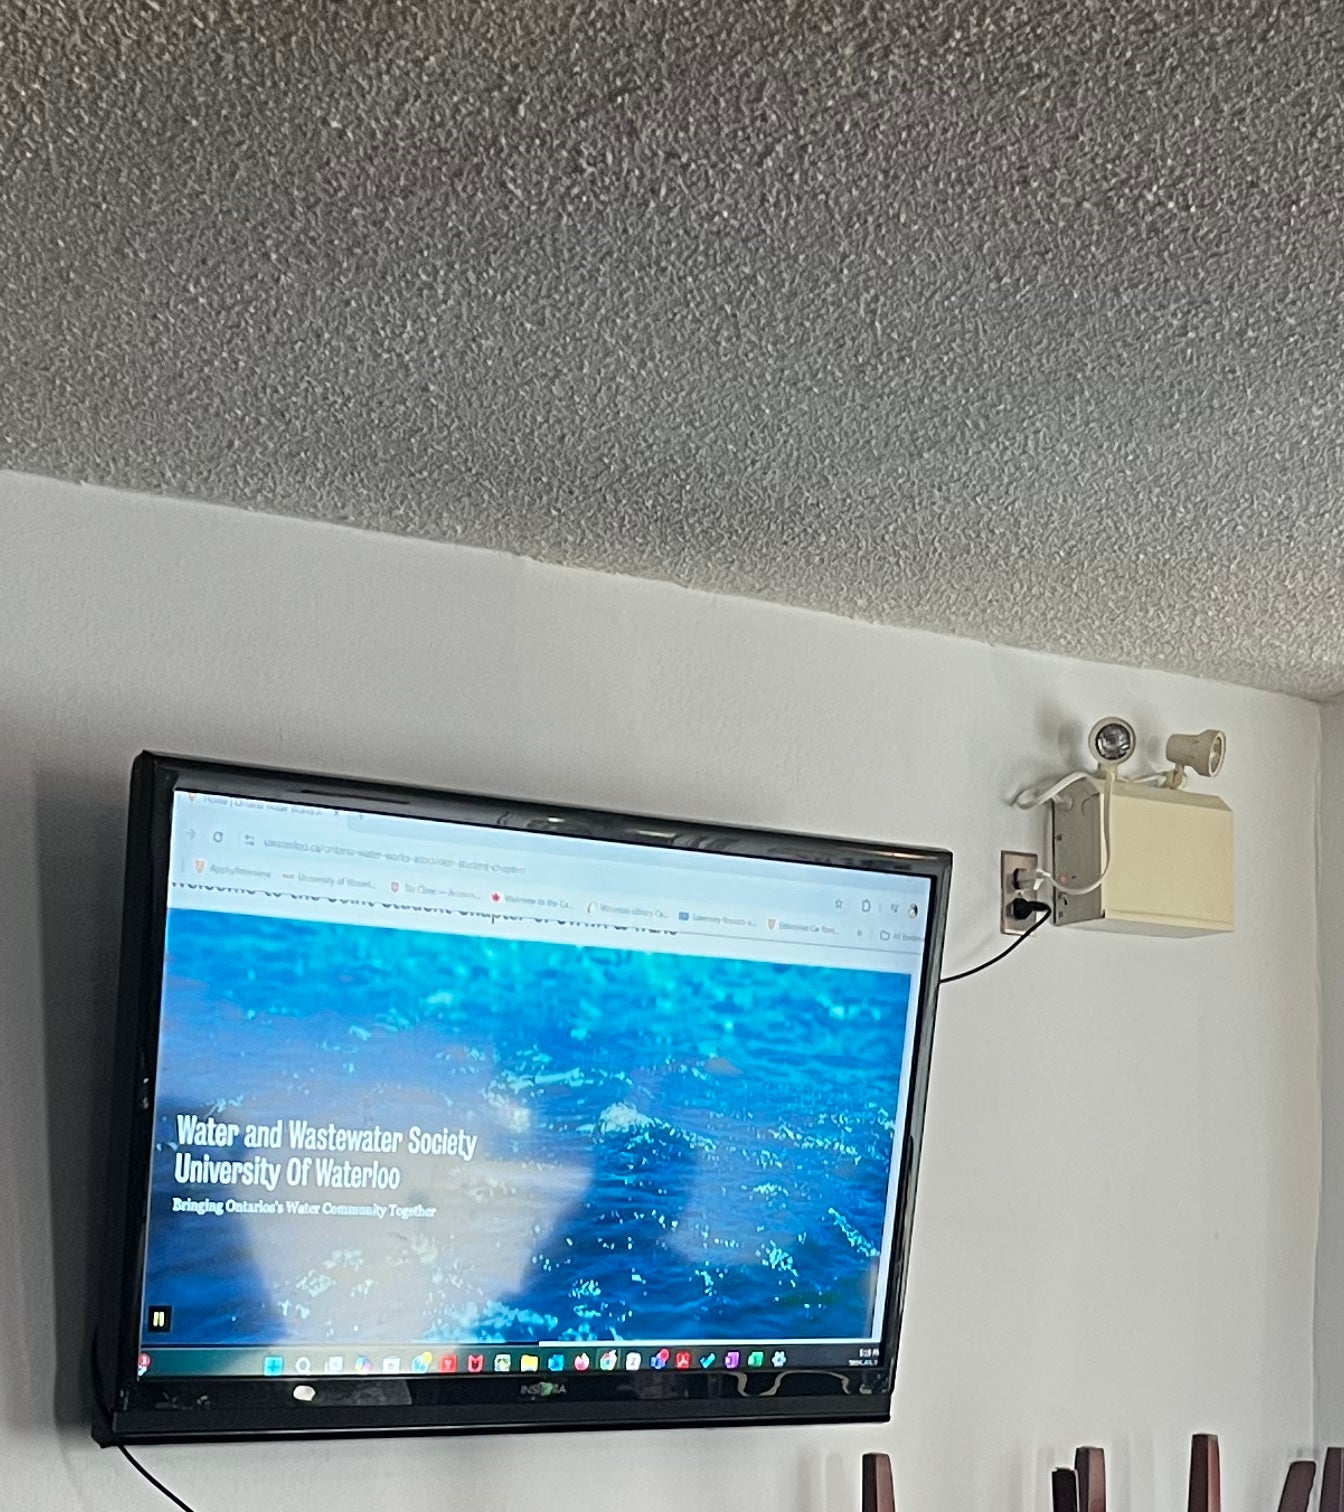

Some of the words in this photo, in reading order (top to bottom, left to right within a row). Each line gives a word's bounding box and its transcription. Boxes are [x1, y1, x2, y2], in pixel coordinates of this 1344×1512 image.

[177, 1114, 240, 1147] Water
[244, 1119, 283, 1148] and
[288, 1120, 403, 1153] Wastewater
[408, 1125, 478, 1161] Society
[174, 1152, 281, 1191] University
[287, 1157, 312, 1187] Of
[315, 1157, 401, 1190] Waterloo
[172, 1197, 224, 1216] Bringing
[286, 1200, 320, 1214] Water
[322, 1202, 387, 1219] Community
[388, 1204, 437, 1220] Together
